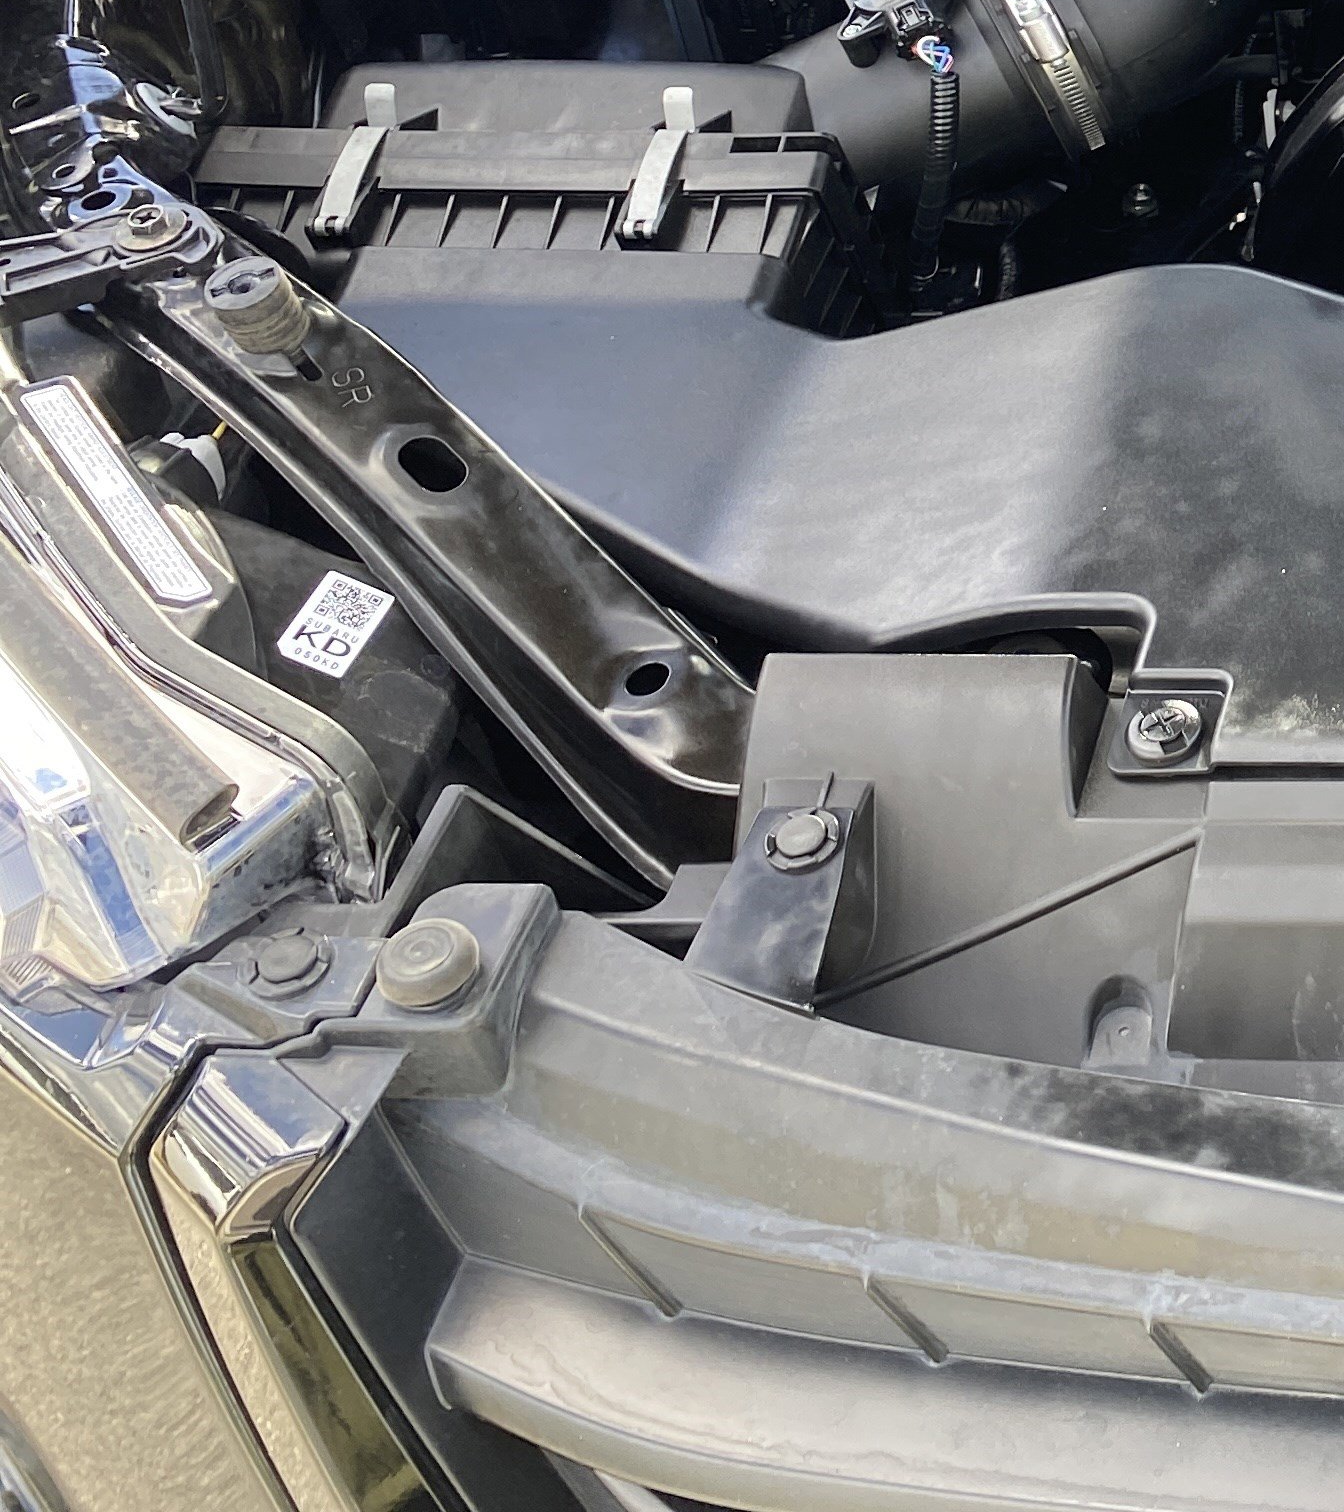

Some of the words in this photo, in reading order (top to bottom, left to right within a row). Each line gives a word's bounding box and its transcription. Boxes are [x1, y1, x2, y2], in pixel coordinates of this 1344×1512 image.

[332, 367, 372, 408] SR
[293, 624, 351, 657] KD
[306, 617, 359, 644] SUBARU
